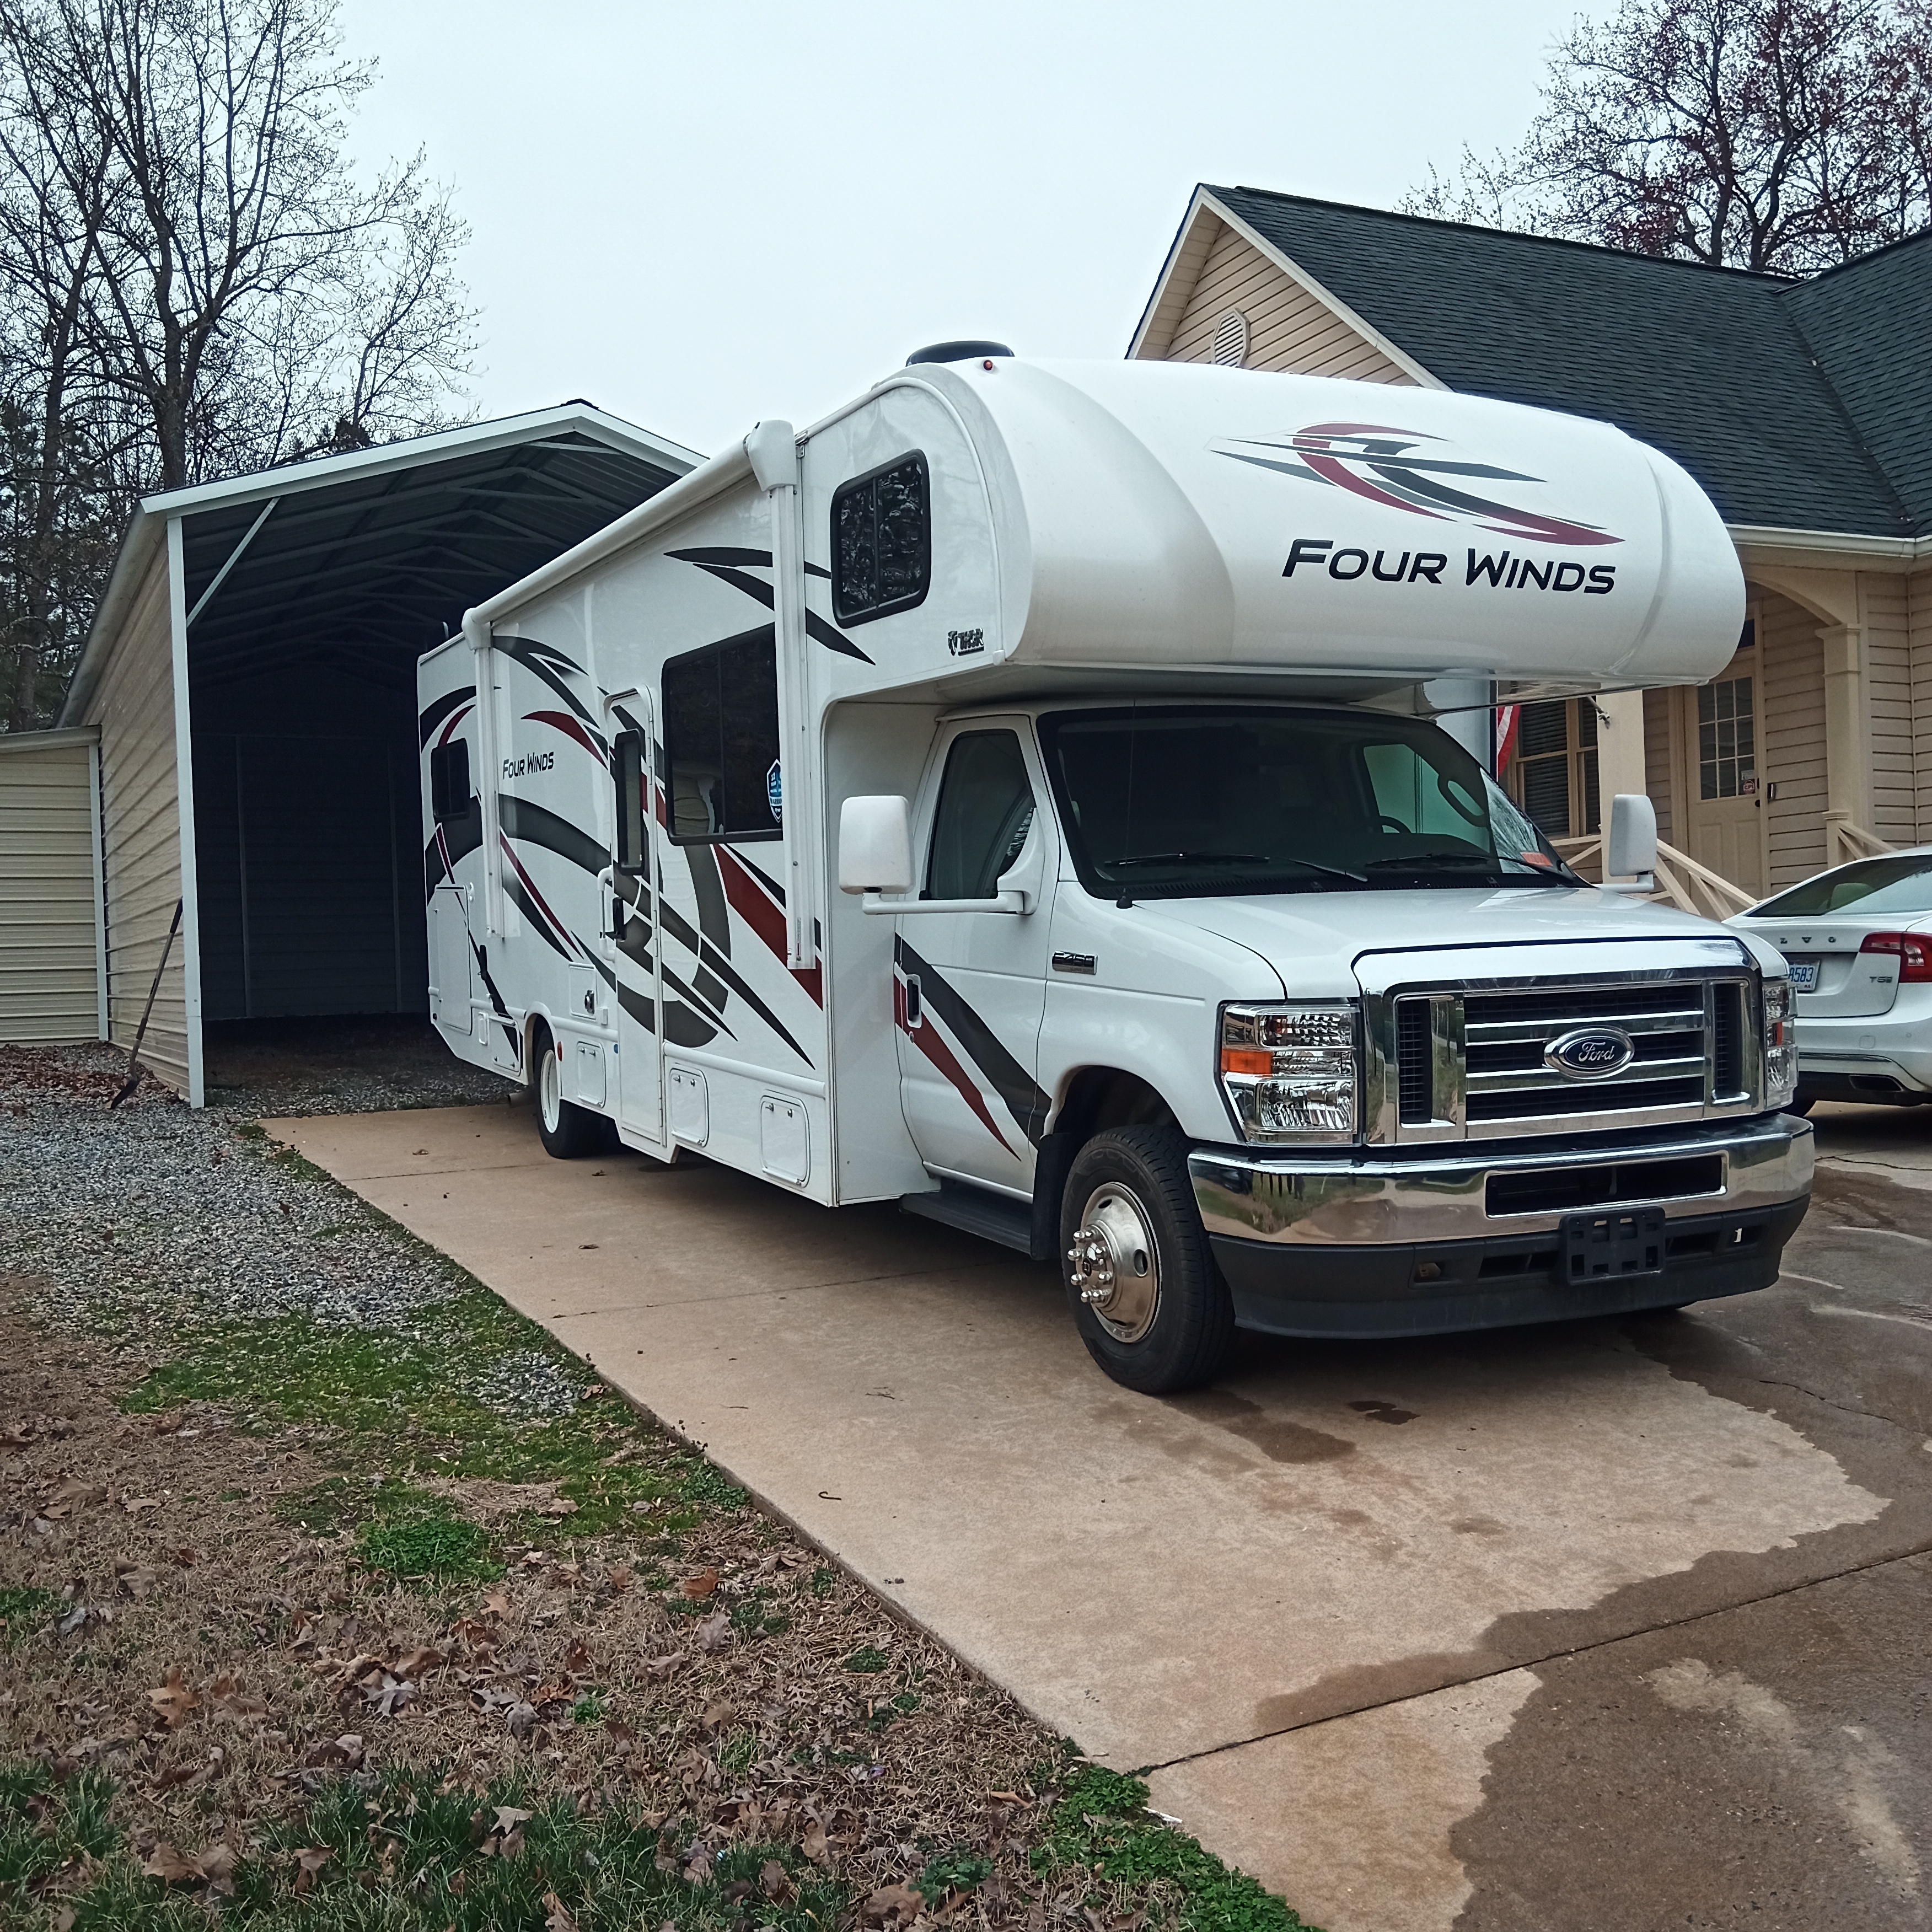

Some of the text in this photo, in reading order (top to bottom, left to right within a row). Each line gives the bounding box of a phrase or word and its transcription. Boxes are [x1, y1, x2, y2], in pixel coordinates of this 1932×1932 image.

[1282, 539, 1616, 594] FOUR WINDS
[503, 752, 554, 780] FOUR WINDS
[1780, 936, 1837, 944] LVO
[1578, 1042, 1615, 1062] Ford
